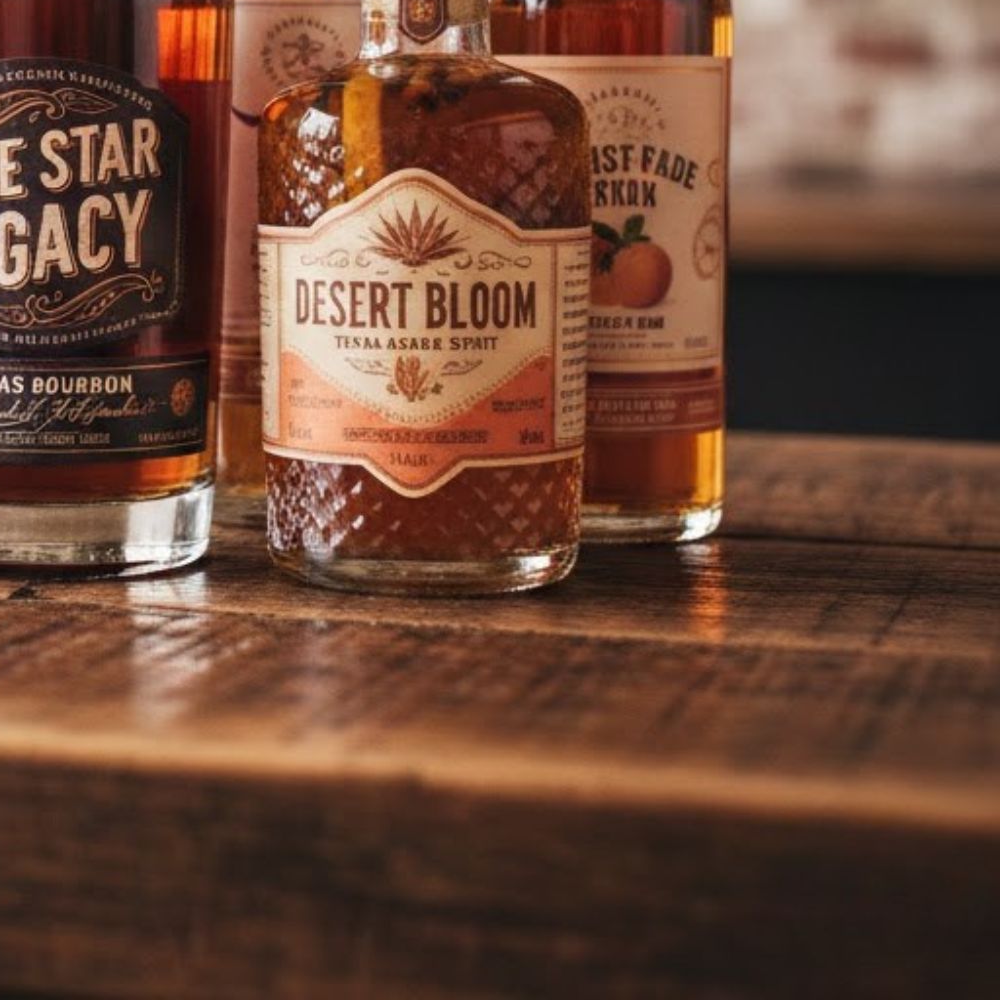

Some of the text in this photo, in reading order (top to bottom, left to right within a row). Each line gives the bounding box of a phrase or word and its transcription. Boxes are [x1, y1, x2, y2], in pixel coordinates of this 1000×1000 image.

[39, 118, 162, 193] STAR
[295, 279, 413, 328] DESERT
[425, 280, 536, 328] BLOOM
[32, 374, 133, 394] BOURBON
